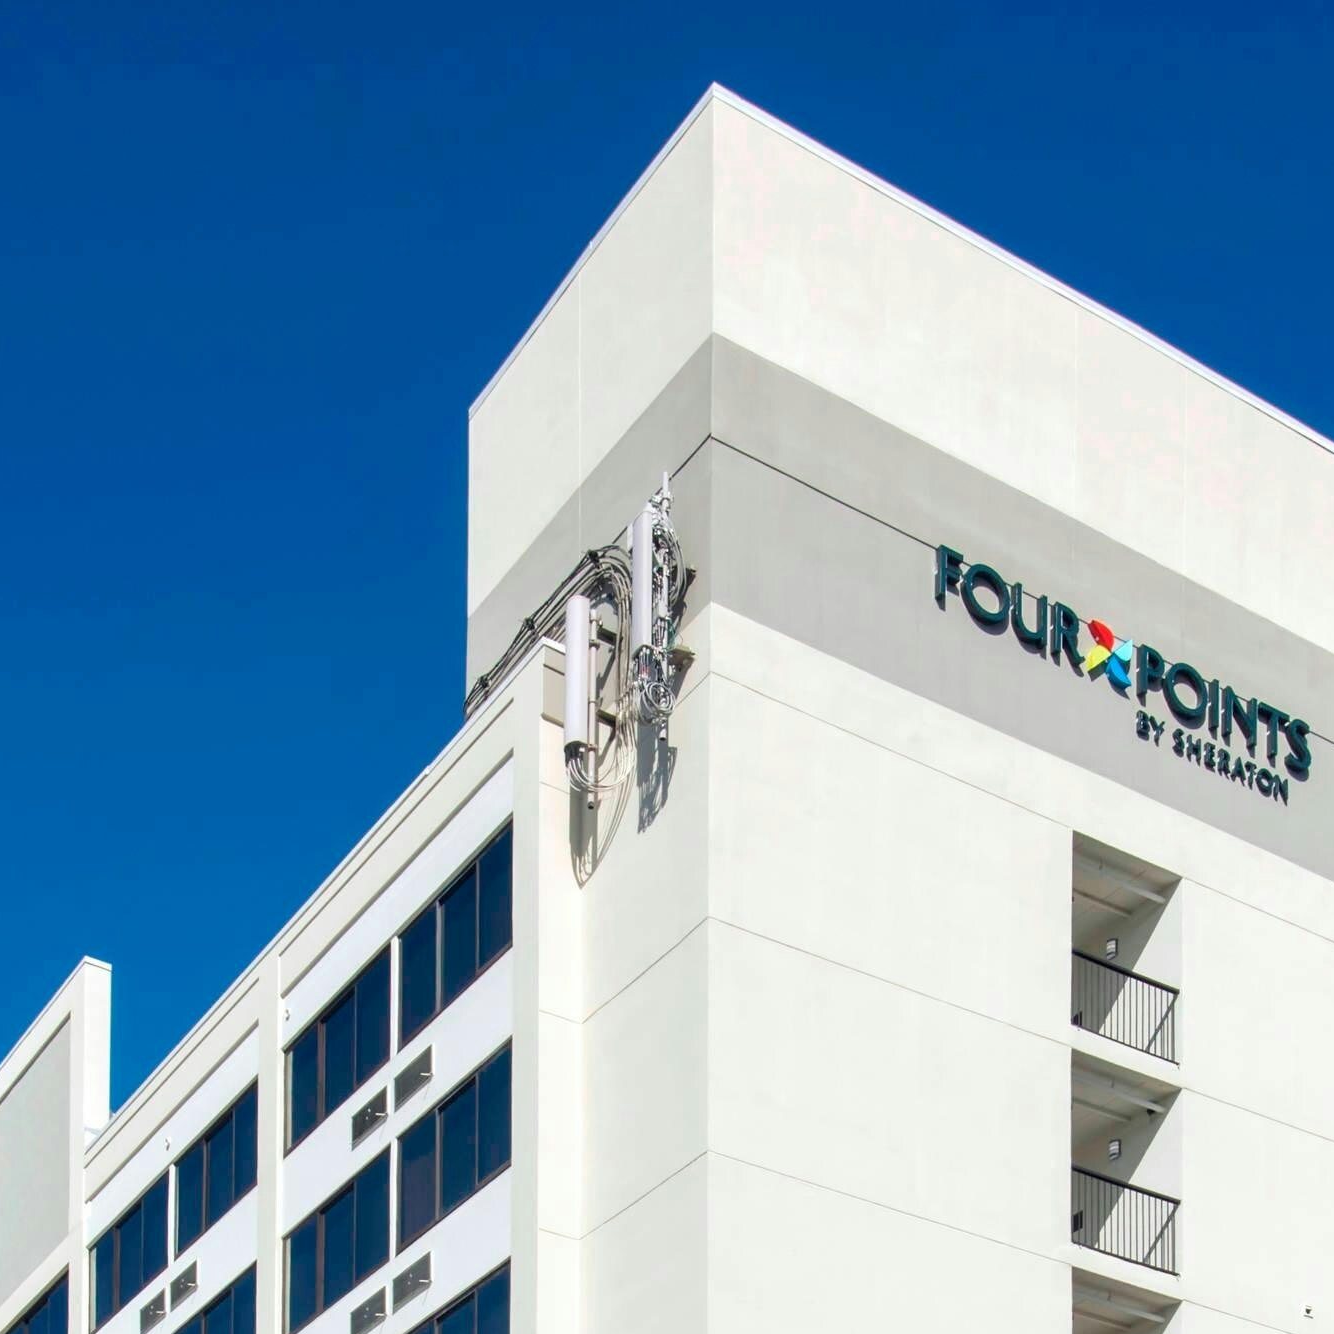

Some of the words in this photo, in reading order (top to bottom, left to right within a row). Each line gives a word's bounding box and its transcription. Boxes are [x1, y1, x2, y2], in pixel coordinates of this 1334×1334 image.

[934, 544, 1085, 668] FOUR
[1136, 644, 1312, 776] POINTS
[1136, 710, 1165, 744] BY
[1173, 728, 1289, 805] SHERATON
